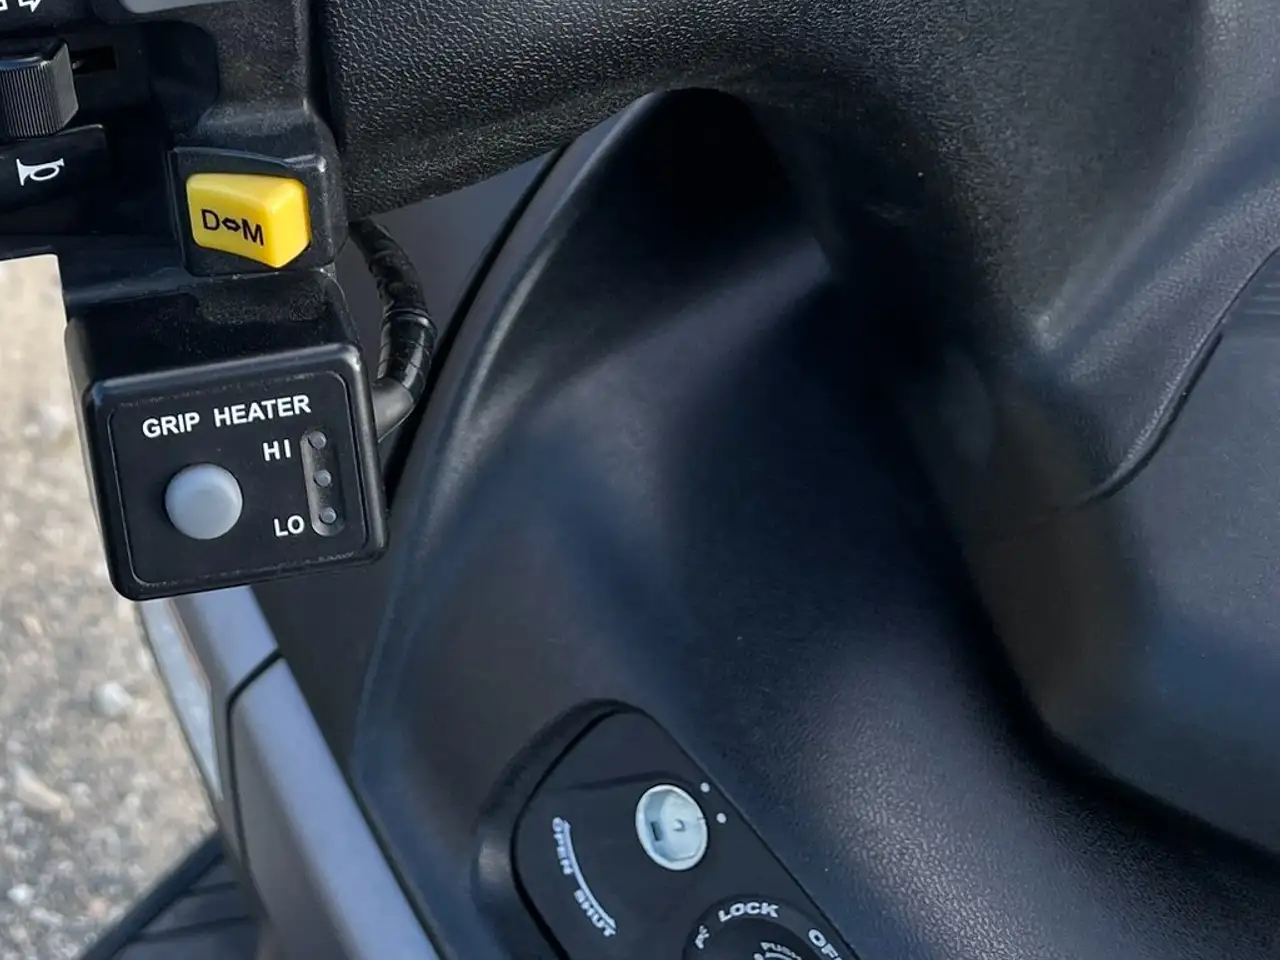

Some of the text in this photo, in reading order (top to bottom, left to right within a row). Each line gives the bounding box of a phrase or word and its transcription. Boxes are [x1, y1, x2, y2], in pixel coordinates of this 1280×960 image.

[142, 394, 312, 438] GRIP HEATER
[262, 438, 292, 461] HI
[273, 514, 306, 538] LO
[574, 889, 616, 937] SHUT
[718, 901, 780, 923] LOCK
[808, 928, 844, 960] OF
